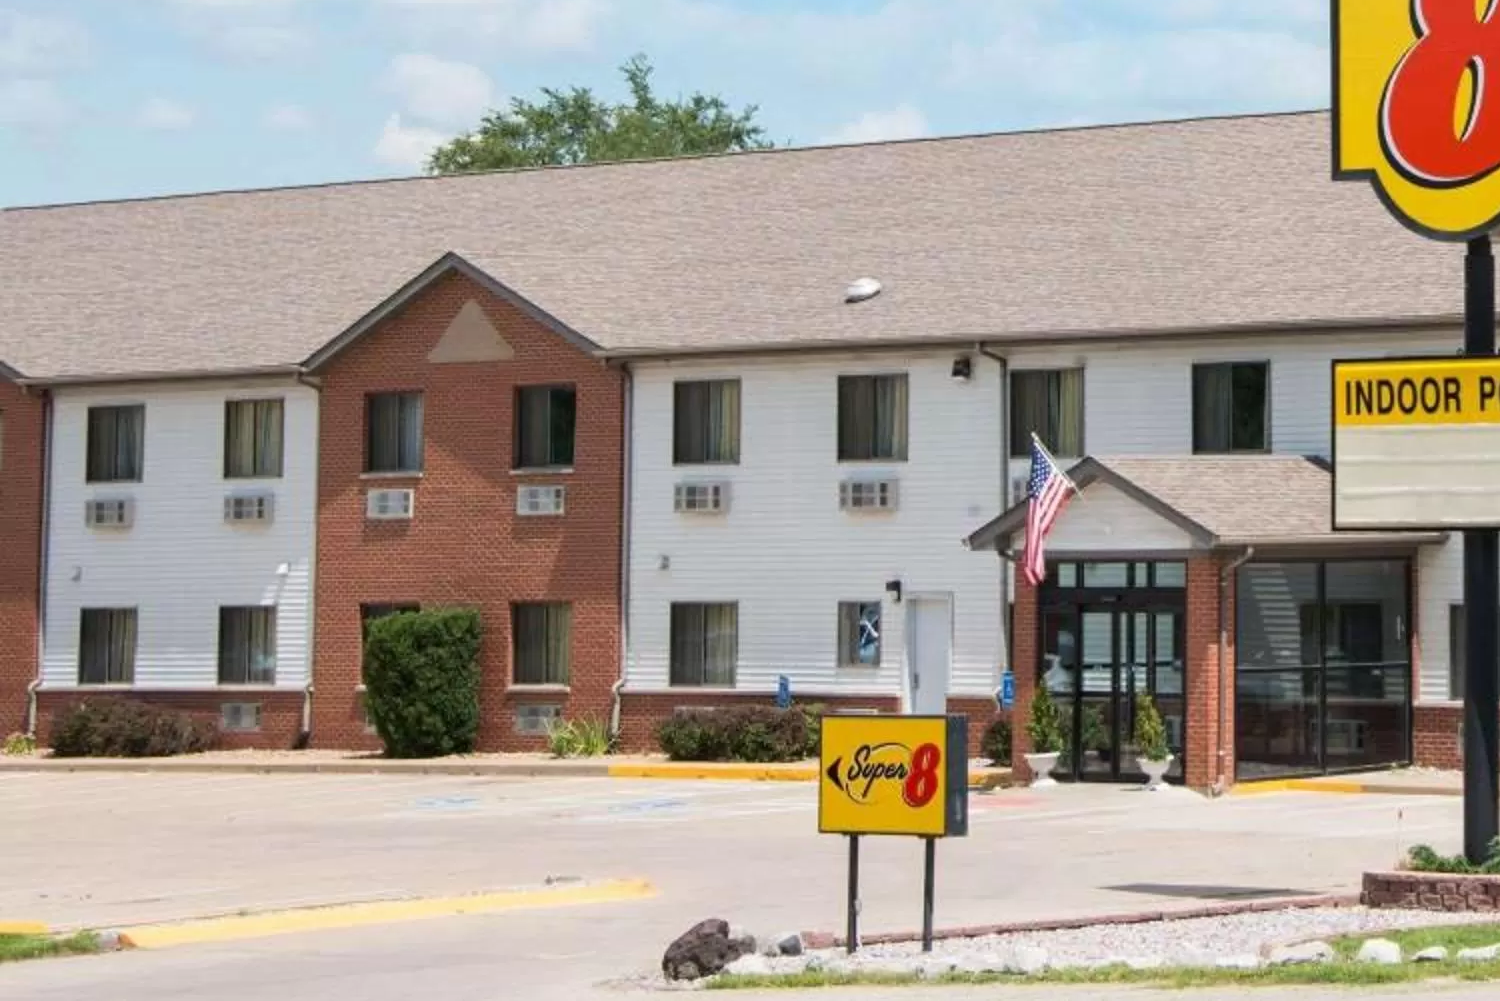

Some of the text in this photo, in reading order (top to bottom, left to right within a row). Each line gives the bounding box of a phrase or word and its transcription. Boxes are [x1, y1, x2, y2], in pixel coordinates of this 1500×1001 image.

[1345, 376, 1462, 416] INDOOR
[847, 742, 942, 808] Super 8
